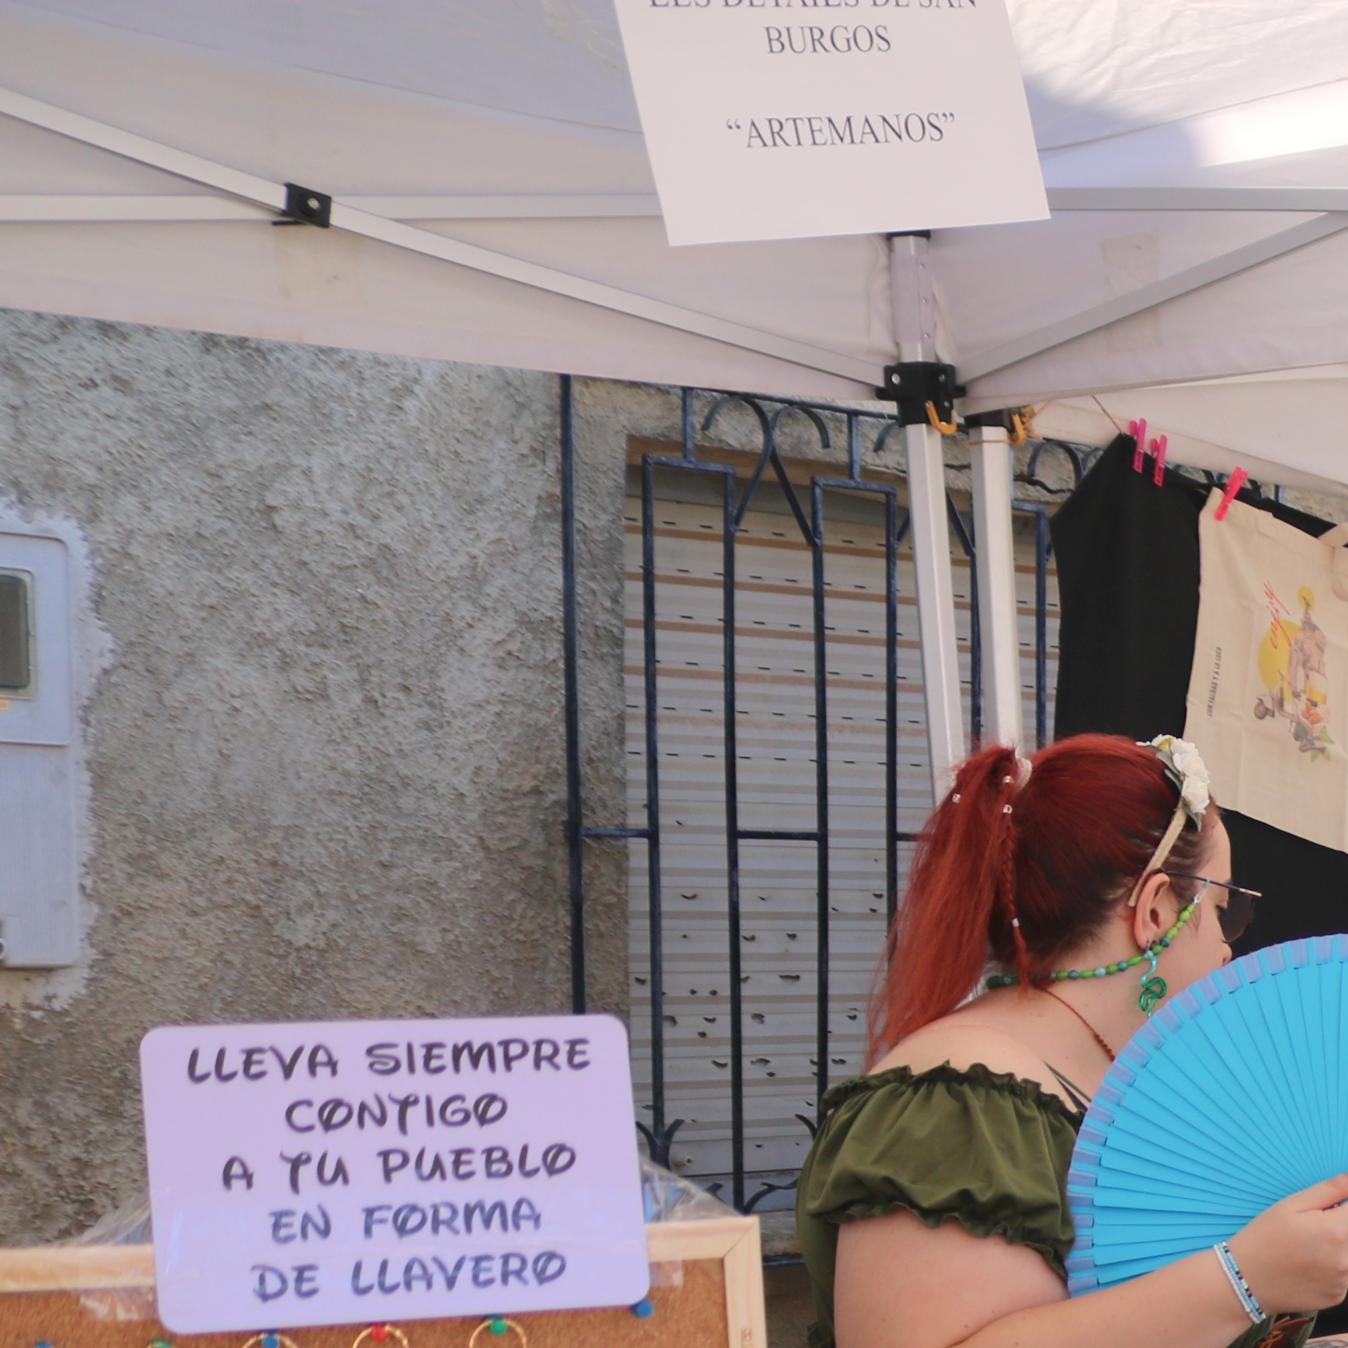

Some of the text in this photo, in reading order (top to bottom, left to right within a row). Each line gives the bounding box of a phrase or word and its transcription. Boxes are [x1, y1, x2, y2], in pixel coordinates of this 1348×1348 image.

[763, 24, 892, 55] BURGOS
[187, 1037, 592, 1083] LLEVA SIEMPRE
[284, 1092, 508, 1135] CONTIGO
[221, 1142, 578, 1194] A TU PUEBLO
[269, 1197, 543, 1245] EN FORMA
[250, 1251, 568, 1303] DE LLAVERO
